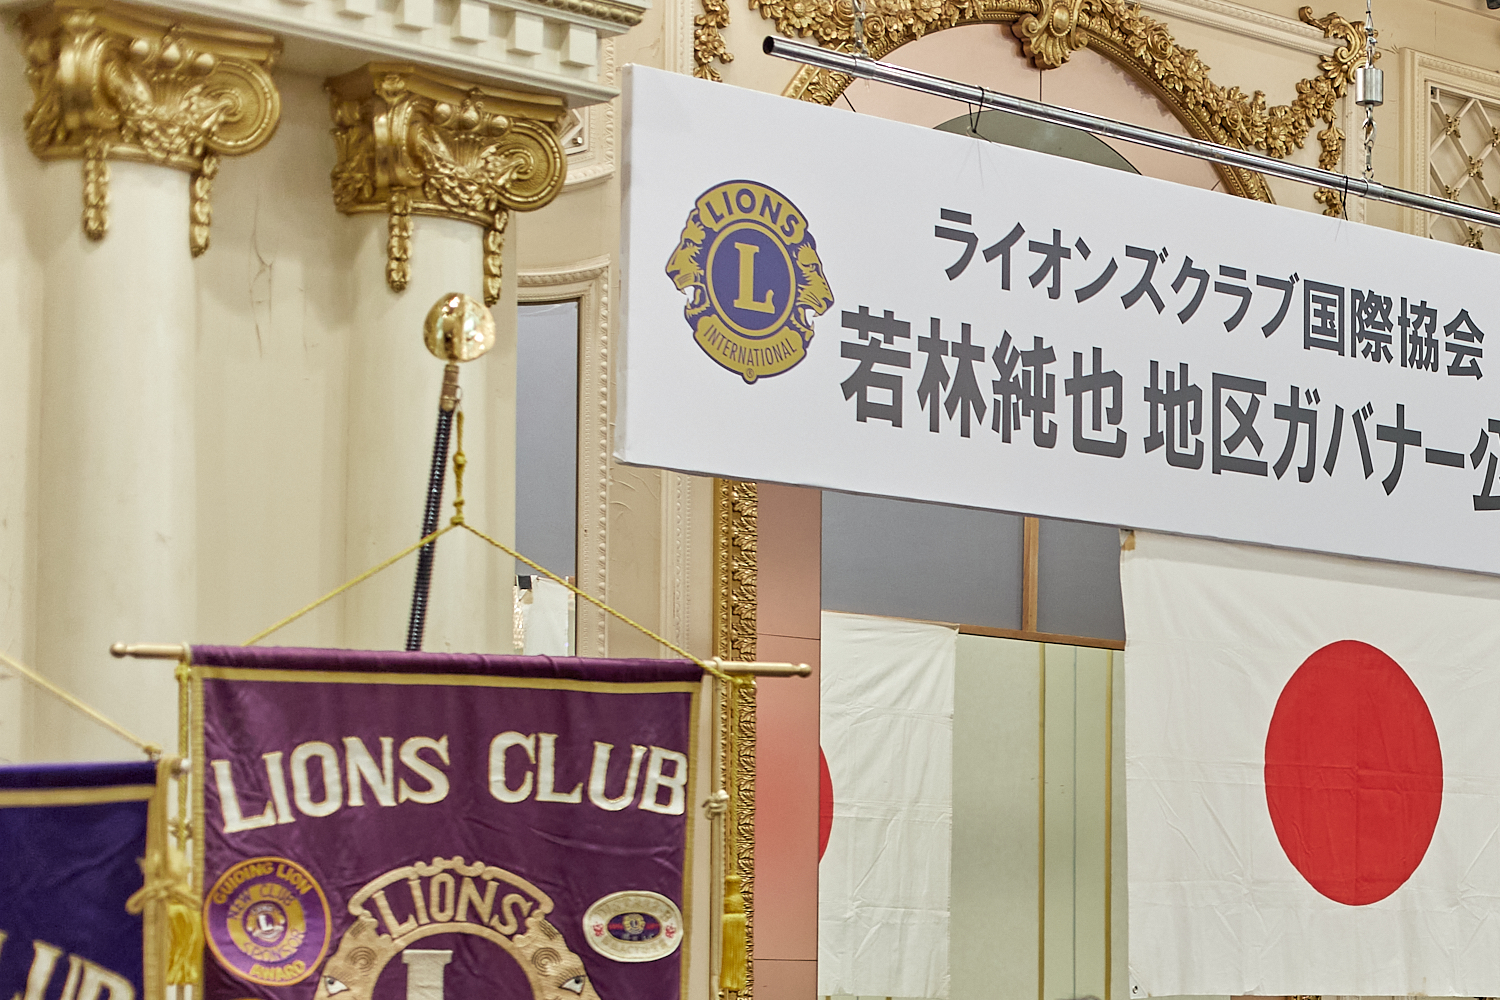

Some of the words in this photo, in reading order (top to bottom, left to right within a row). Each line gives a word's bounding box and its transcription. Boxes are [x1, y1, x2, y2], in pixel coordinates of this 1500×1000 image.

[705, 188, 799, 238] LIONS
[734, 242, 775, 314] L
[935, 208, 1485, 381] ライオンズクラブ国際協会
[703, 324, 798, 367] INTERNATIONAL
[840, 305, 1128, 459] 若林純也
[210, 735, 451, 834] LIONS
[488, 730, 689, 817] CLUB
[276, 864, 313, 895] LION
[372, 873, 534, 939] LIONS
[249, 960, 306, 981] AWARD
